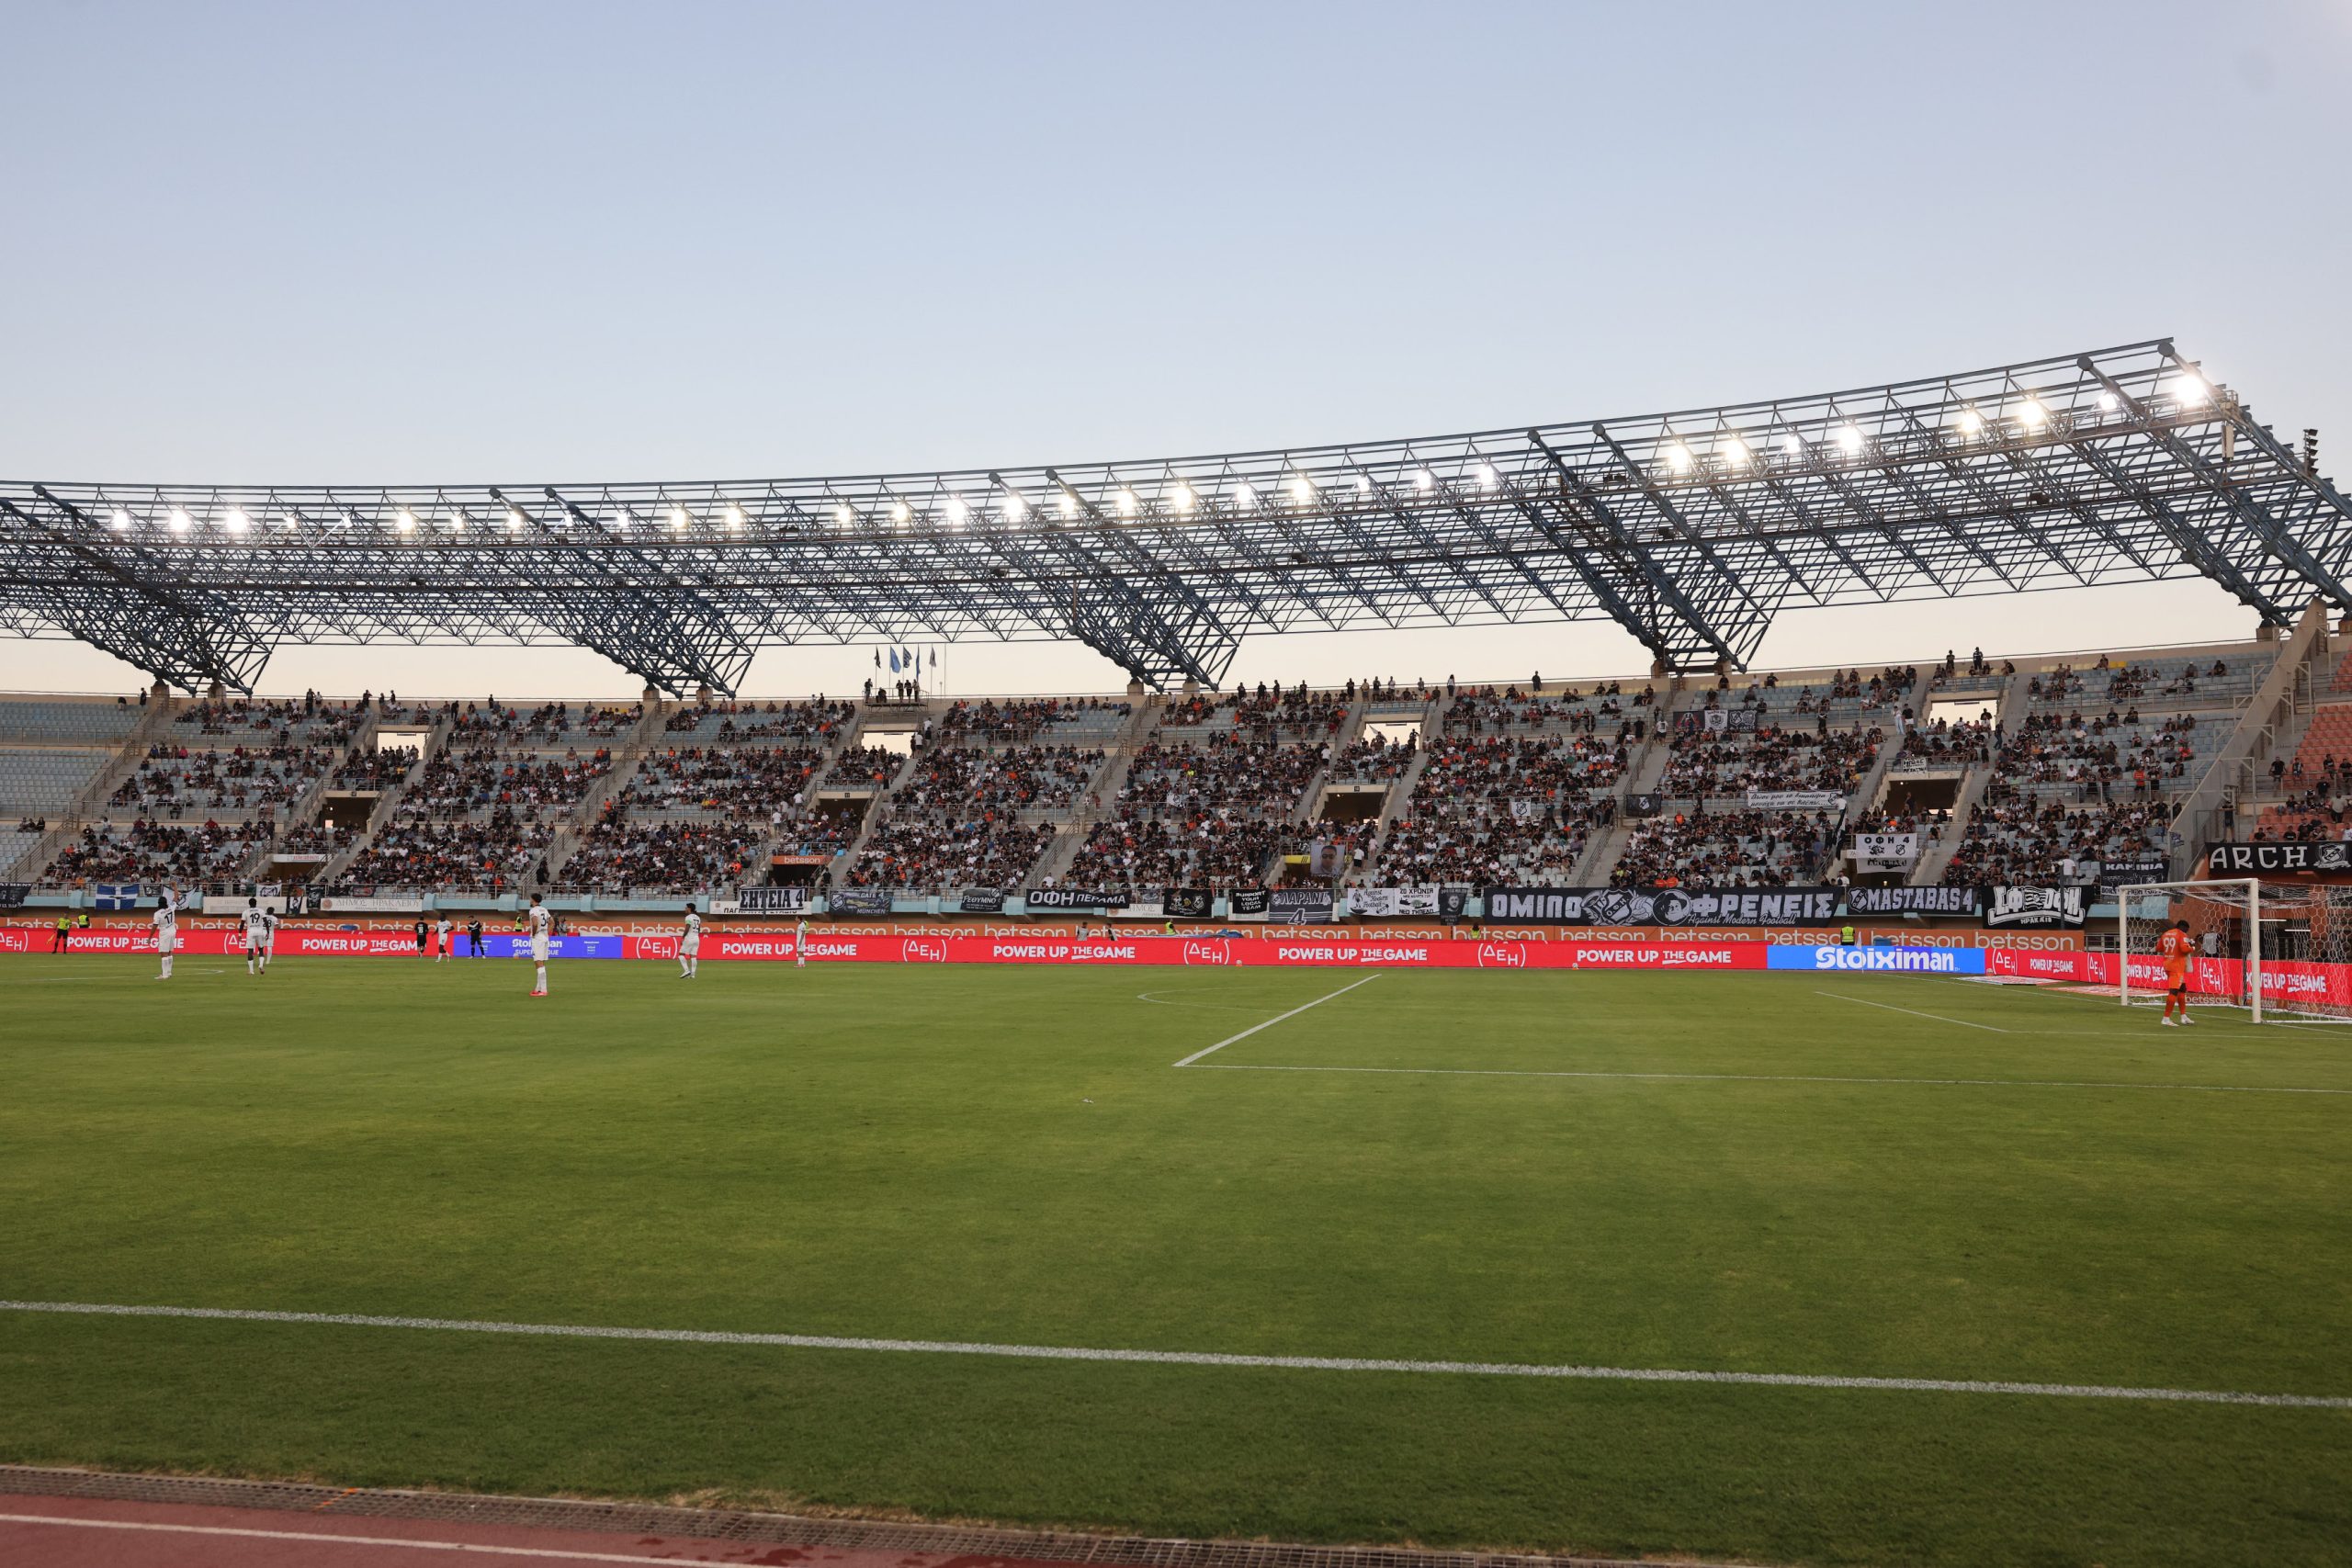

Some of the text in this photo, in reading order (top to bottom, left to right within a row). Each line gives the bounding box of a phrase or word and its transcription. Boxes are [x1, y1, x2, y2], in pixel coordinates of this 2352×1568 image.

[2210, 846, 2307, 869] ARCH
[796, 890, 804, 908] 4
[1030, 891, 1075, 906] ΟΦΗ
[1867, 888, 1973, 911] MASTABAS 4
[250, 912, 261, 923] 19
[1287, 908, 1307, 925] 4
[1723, 914, 1757, 924] Modern
[67, 937, 112, 948] POWER
[113, 938, 130, 948] UP
[132, 937, 148, 945] THE
[1764, 929, 1841, 945] betsso
[1975, 931, 2074, 952] betsson
[302, 939, 418, 951] POWER UP THE GAM
[722, 942, 772, 954] POWER
[775, 943, 794, 955] UP
[817, 944, 857, 956] GAME
[993, 945, 1136, 959] POWER UP THE GAME
[2164, 937, 2176, 953] 99
[1279, 947, 1427, 961] POWER UP THE GAME
[1577, 950, 1731, 964] POWER UP THE GAME
[1815, 946, 1954, 971] Stoiximan
[2030, 958, 2047, 970] POWER
[2047, 960, 2052, 971] UP
[2059, 961, 2074, 973] GAME
[2126, 964, 2143, 978] OWER
[2143, 965, 2151, 979] UP
[2274, 973, 2286, 989] UP
[2288, 974, 2300, 987] THE
[2300, 975, 2326, 993] GAME
